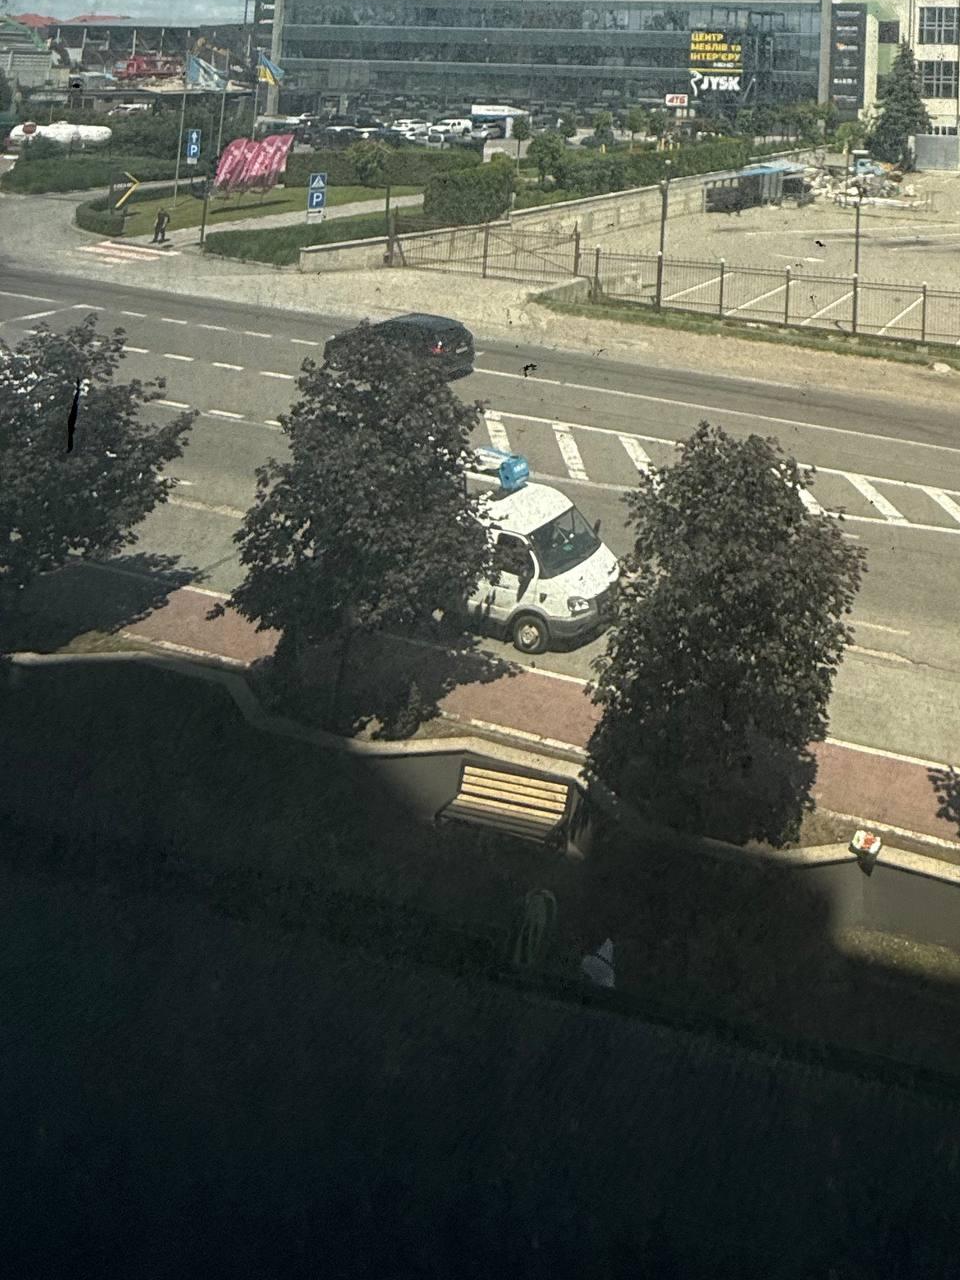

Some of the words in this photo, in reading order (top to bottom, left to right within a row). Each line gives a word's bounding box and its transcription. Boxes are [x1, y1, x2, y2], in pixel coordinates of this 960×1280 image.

[691, 32, 724, 41] ЦЕНТР
[700, 76, 741, 91] JYSK
[190, 145, 198, 156] P
[313, 193, 323, 206] P
